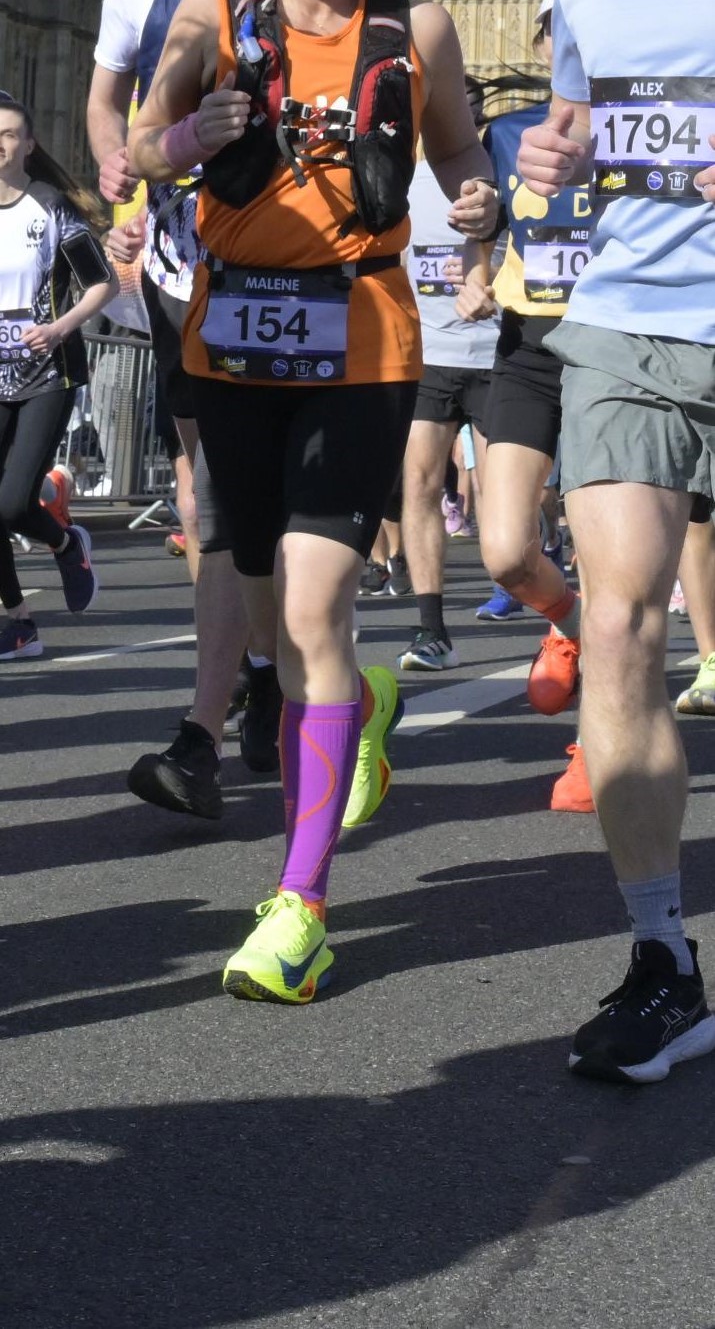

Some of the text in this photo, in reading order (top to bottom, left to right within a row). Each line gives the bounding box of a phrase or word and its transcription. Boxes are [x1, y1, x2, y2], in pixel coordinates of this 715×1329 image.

[629, 82, 664, 96] ALEX
[604, 113, 701, 154] 1794
[245, 276, 300, 291] MALENE
[233, 304, 311, 344] 154
